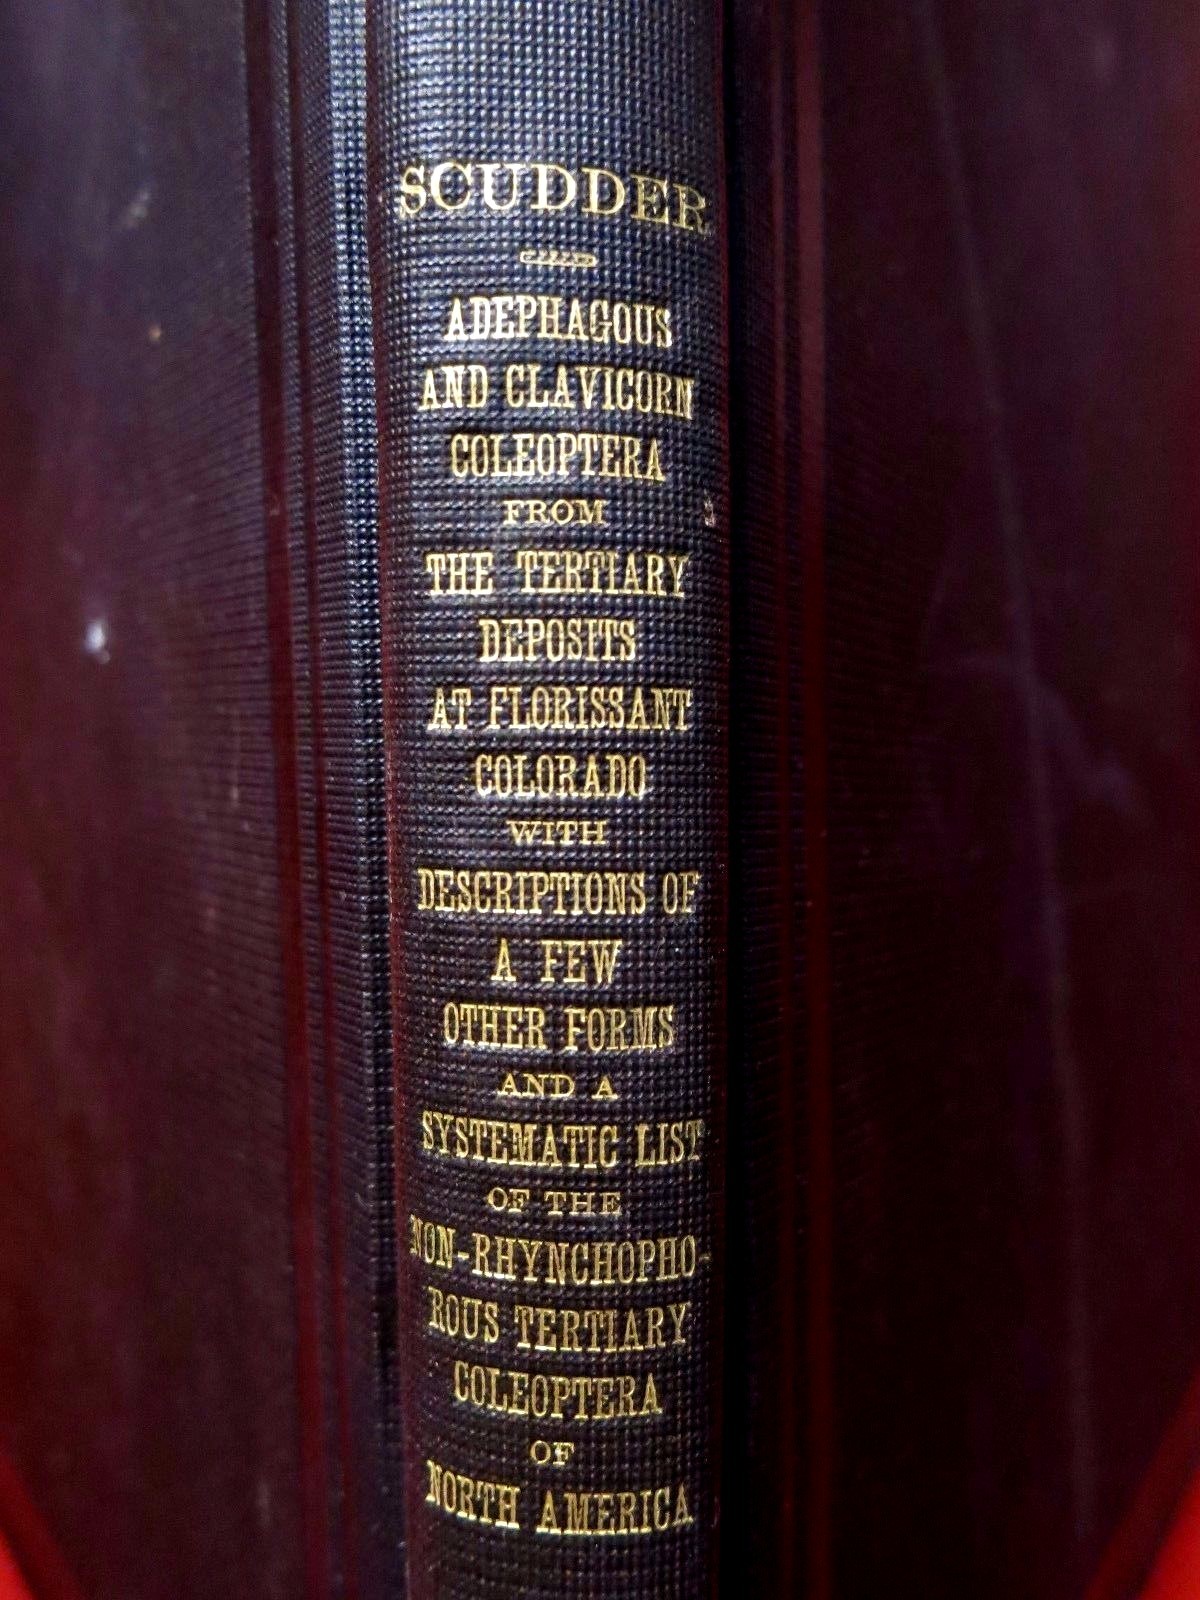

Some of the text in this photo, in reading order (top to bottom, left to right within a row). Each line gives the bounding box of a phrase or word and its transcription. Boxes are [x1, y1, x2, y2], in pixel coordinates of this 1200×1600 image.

[399, 163, 709, 232] SCUDDER
[444, 297, 673, 347] ADEPHAGOUS
[419, 366, 694, 420] AND CLAVICORN
[450, 433, 666, 482] COLEOPTERA
[503, 499, 607, 525] FROM
[425, 550, 690, 597] THE TERTIARY
[479, 619, 636, 662] DEPOSITS
[428, 686, 692, 731] AT FLORISSANT
[475, 754, 647, 798] COLORADO
[507, 820, 607, 845] WITH
[417, 868, 700, 914] DESCRIPTIONS OF
[491, 938, 622, 983] A FEW
[443, 1002, 674, 1052] OTHER FORMS
[496, 1073, 618, 1099] AND A
[421, 1110, 703, 1169] SYSTEMATIC LIST
[487, 1187, 621, 1215] OF THE
[409, 1214, 711, 1286] NON-RHYNCHOPHO-
[428, 1287, 691, 1353] ROUS TERTIARY
[453, 1361, 663, 1421] COLEOPTERA
[530, 1440, 574, 1466] OF
[426, 1459, 694, 1536] NORTH AMERICA
